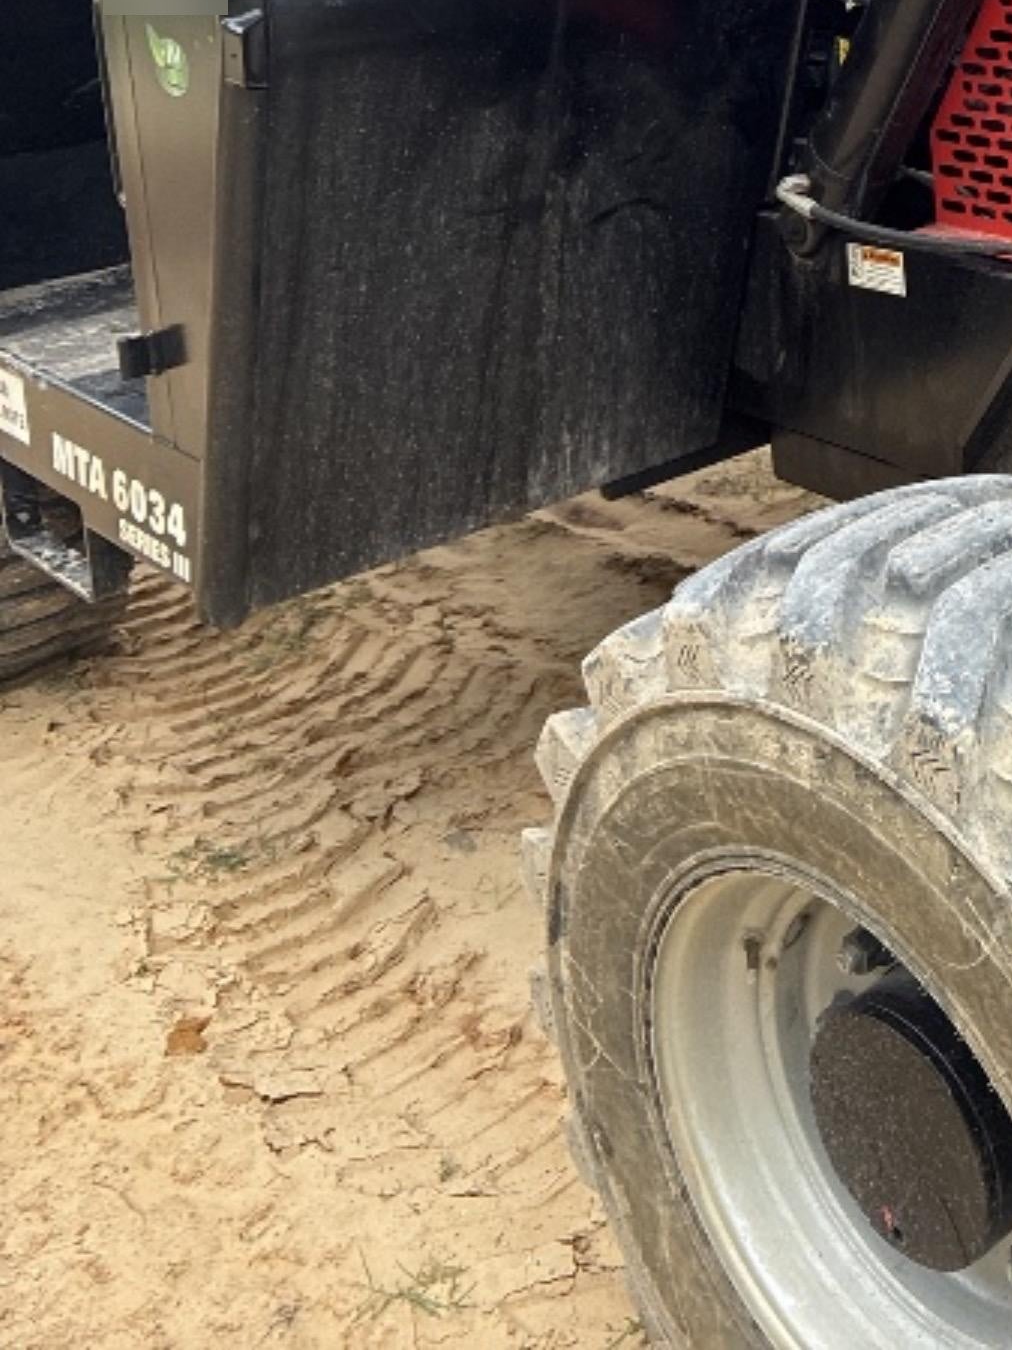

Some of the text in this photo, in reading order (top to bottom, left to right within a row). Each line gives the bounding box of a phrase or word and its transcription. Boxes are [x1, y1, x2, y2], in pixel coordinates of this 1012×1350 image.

[52, 431, 187, 547] MTA 6034
[118, 518, 191, 583] SERIES III
